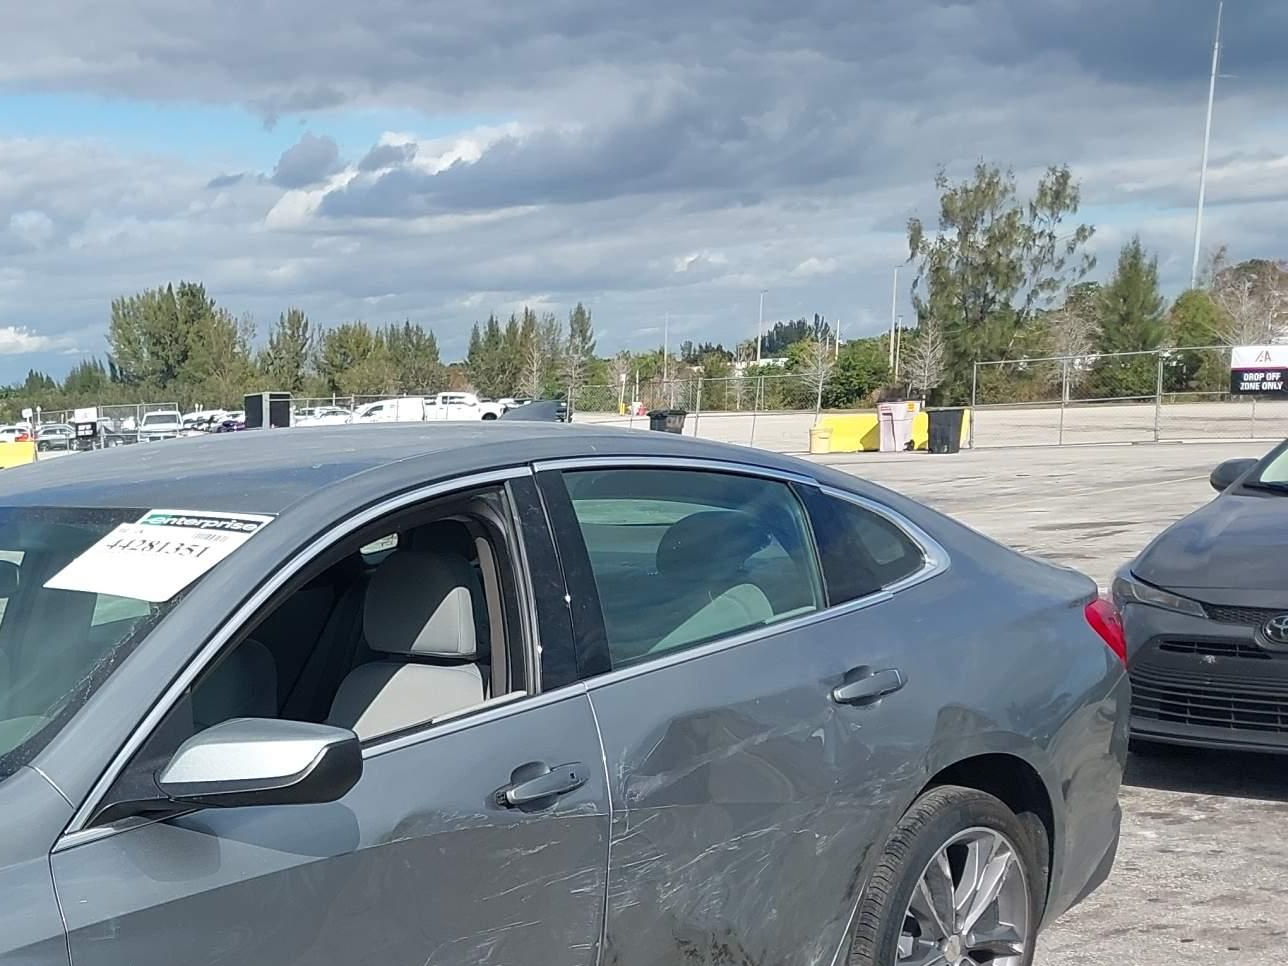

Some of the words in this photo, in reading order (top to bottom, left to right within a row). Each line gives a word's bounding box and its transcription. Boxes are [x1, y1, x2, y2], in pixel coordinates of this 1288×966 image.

[1243, 372, 1264, 381] DROP
[1265, 372, 1282, 381] OFF
[1240, 382, 1261, 391] ZONE
[1261, 381, 1283, 390] ONLY
[148, 514, 259, 532] enterprise
[106, 539, 211, 558] 44281351
